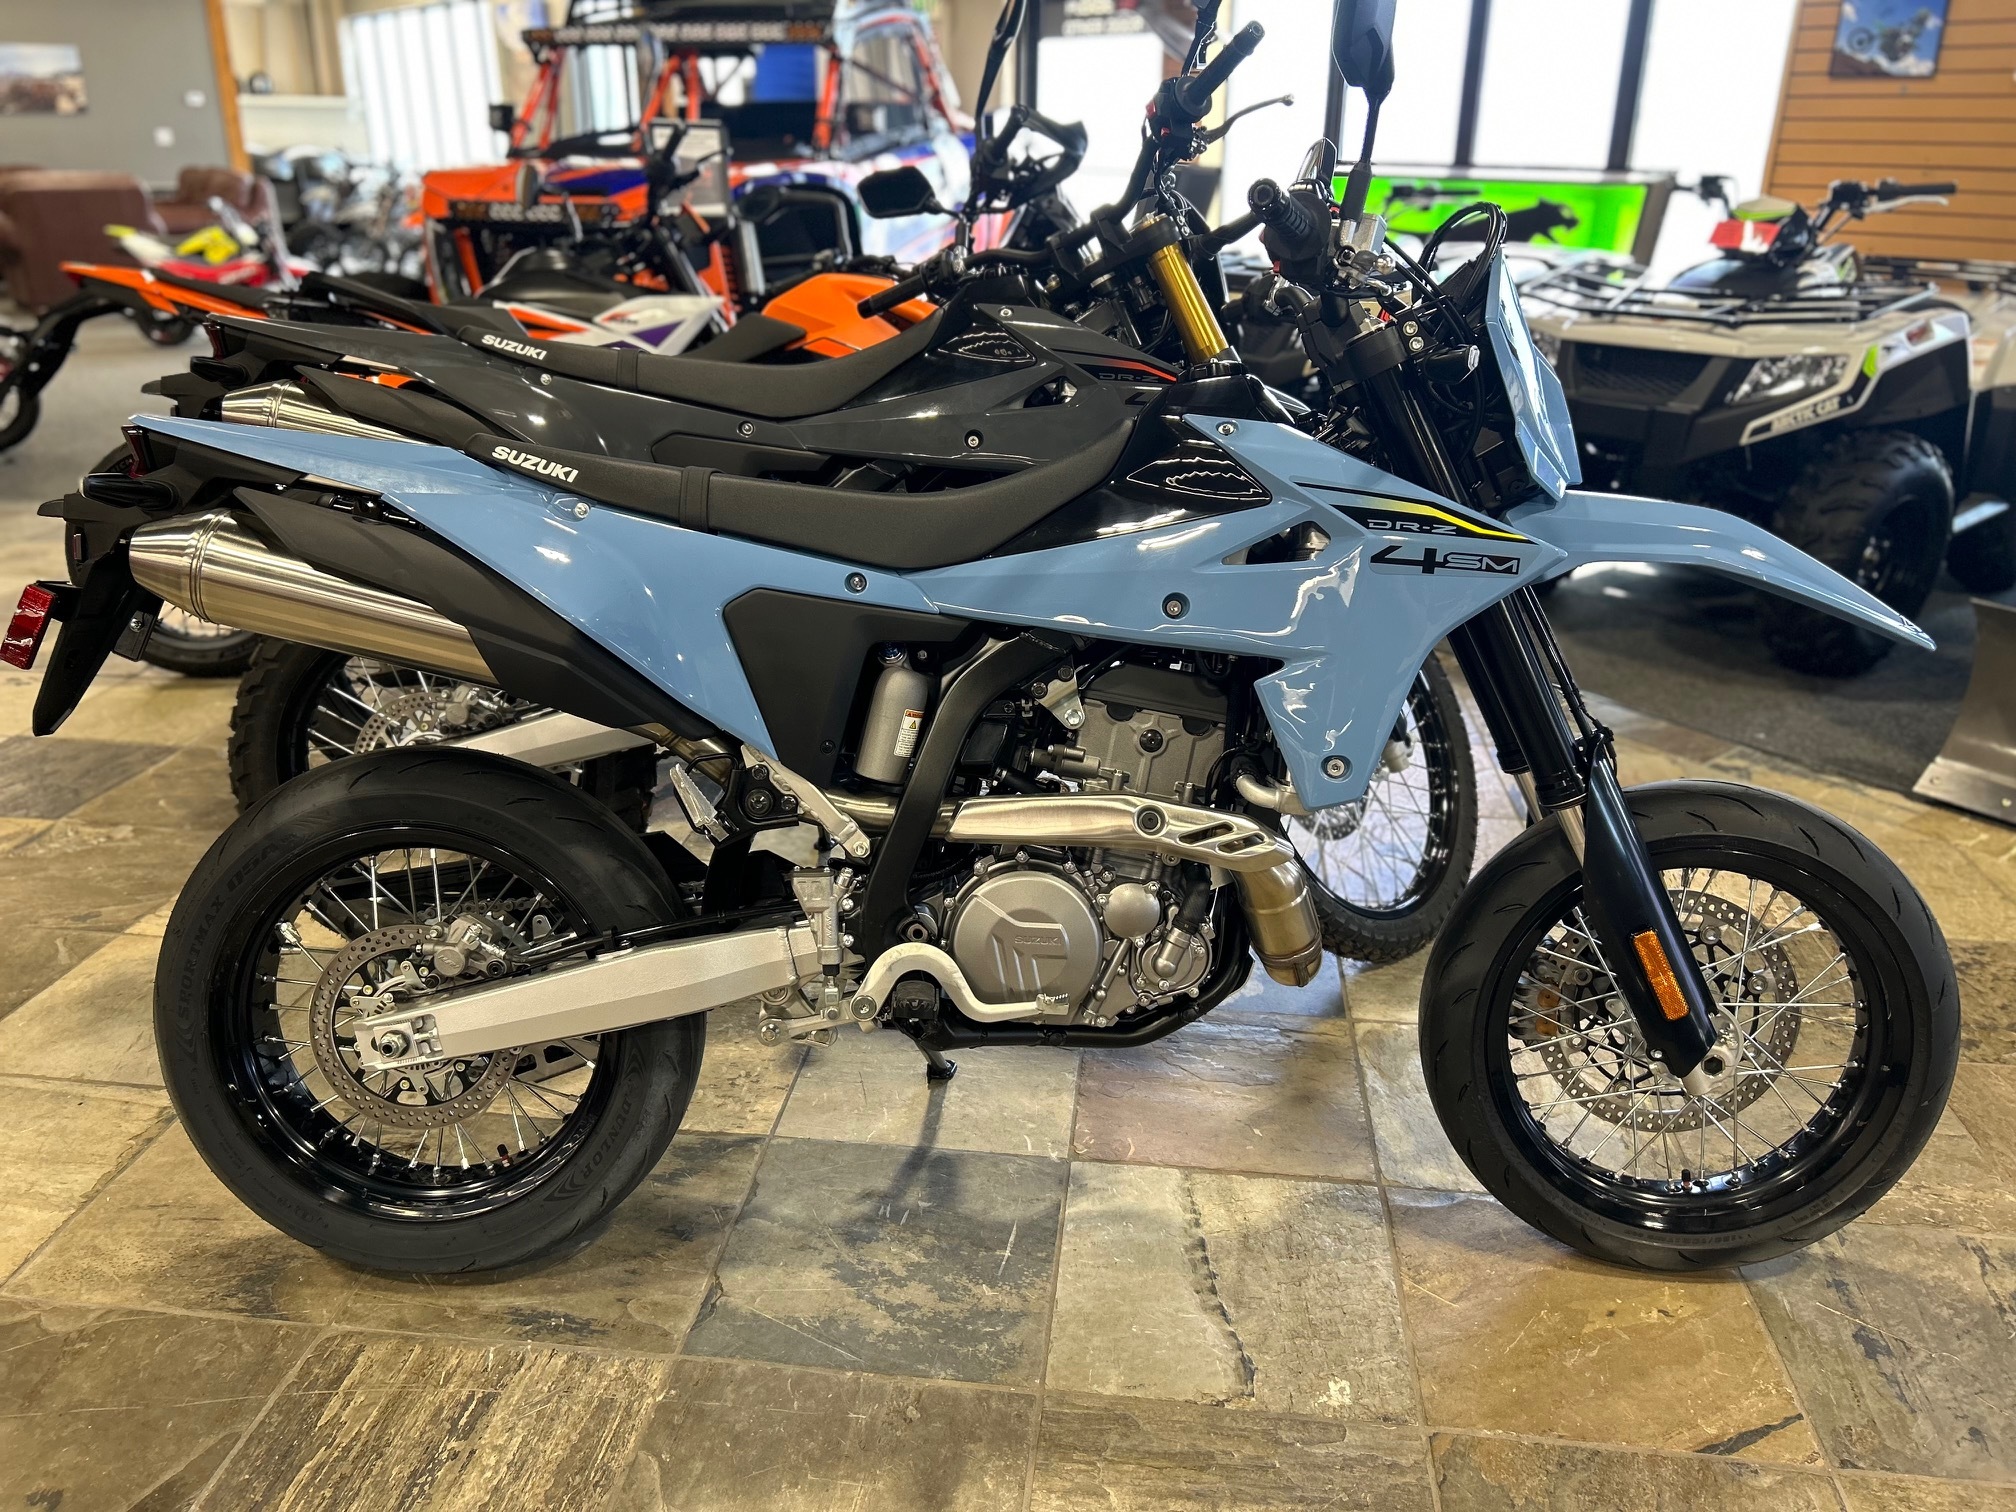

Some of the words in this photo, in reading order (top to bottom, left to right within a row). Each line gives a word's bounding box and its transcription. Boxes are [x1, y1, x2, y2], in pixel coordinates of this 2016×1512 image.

[481, 334, 547, 360] SUZUKI
[1099, 372, 1159, 383] DR-Z
[492, 446, 579, 483] SUZUKI
[1367, 519, 1457, 535] DR-Z
[1014, 935, 1062, 946] SUZUKI
[177, 894, 226, 1020] SPORTMAX
[580, 1096, 632, 1180] DUNLOP
